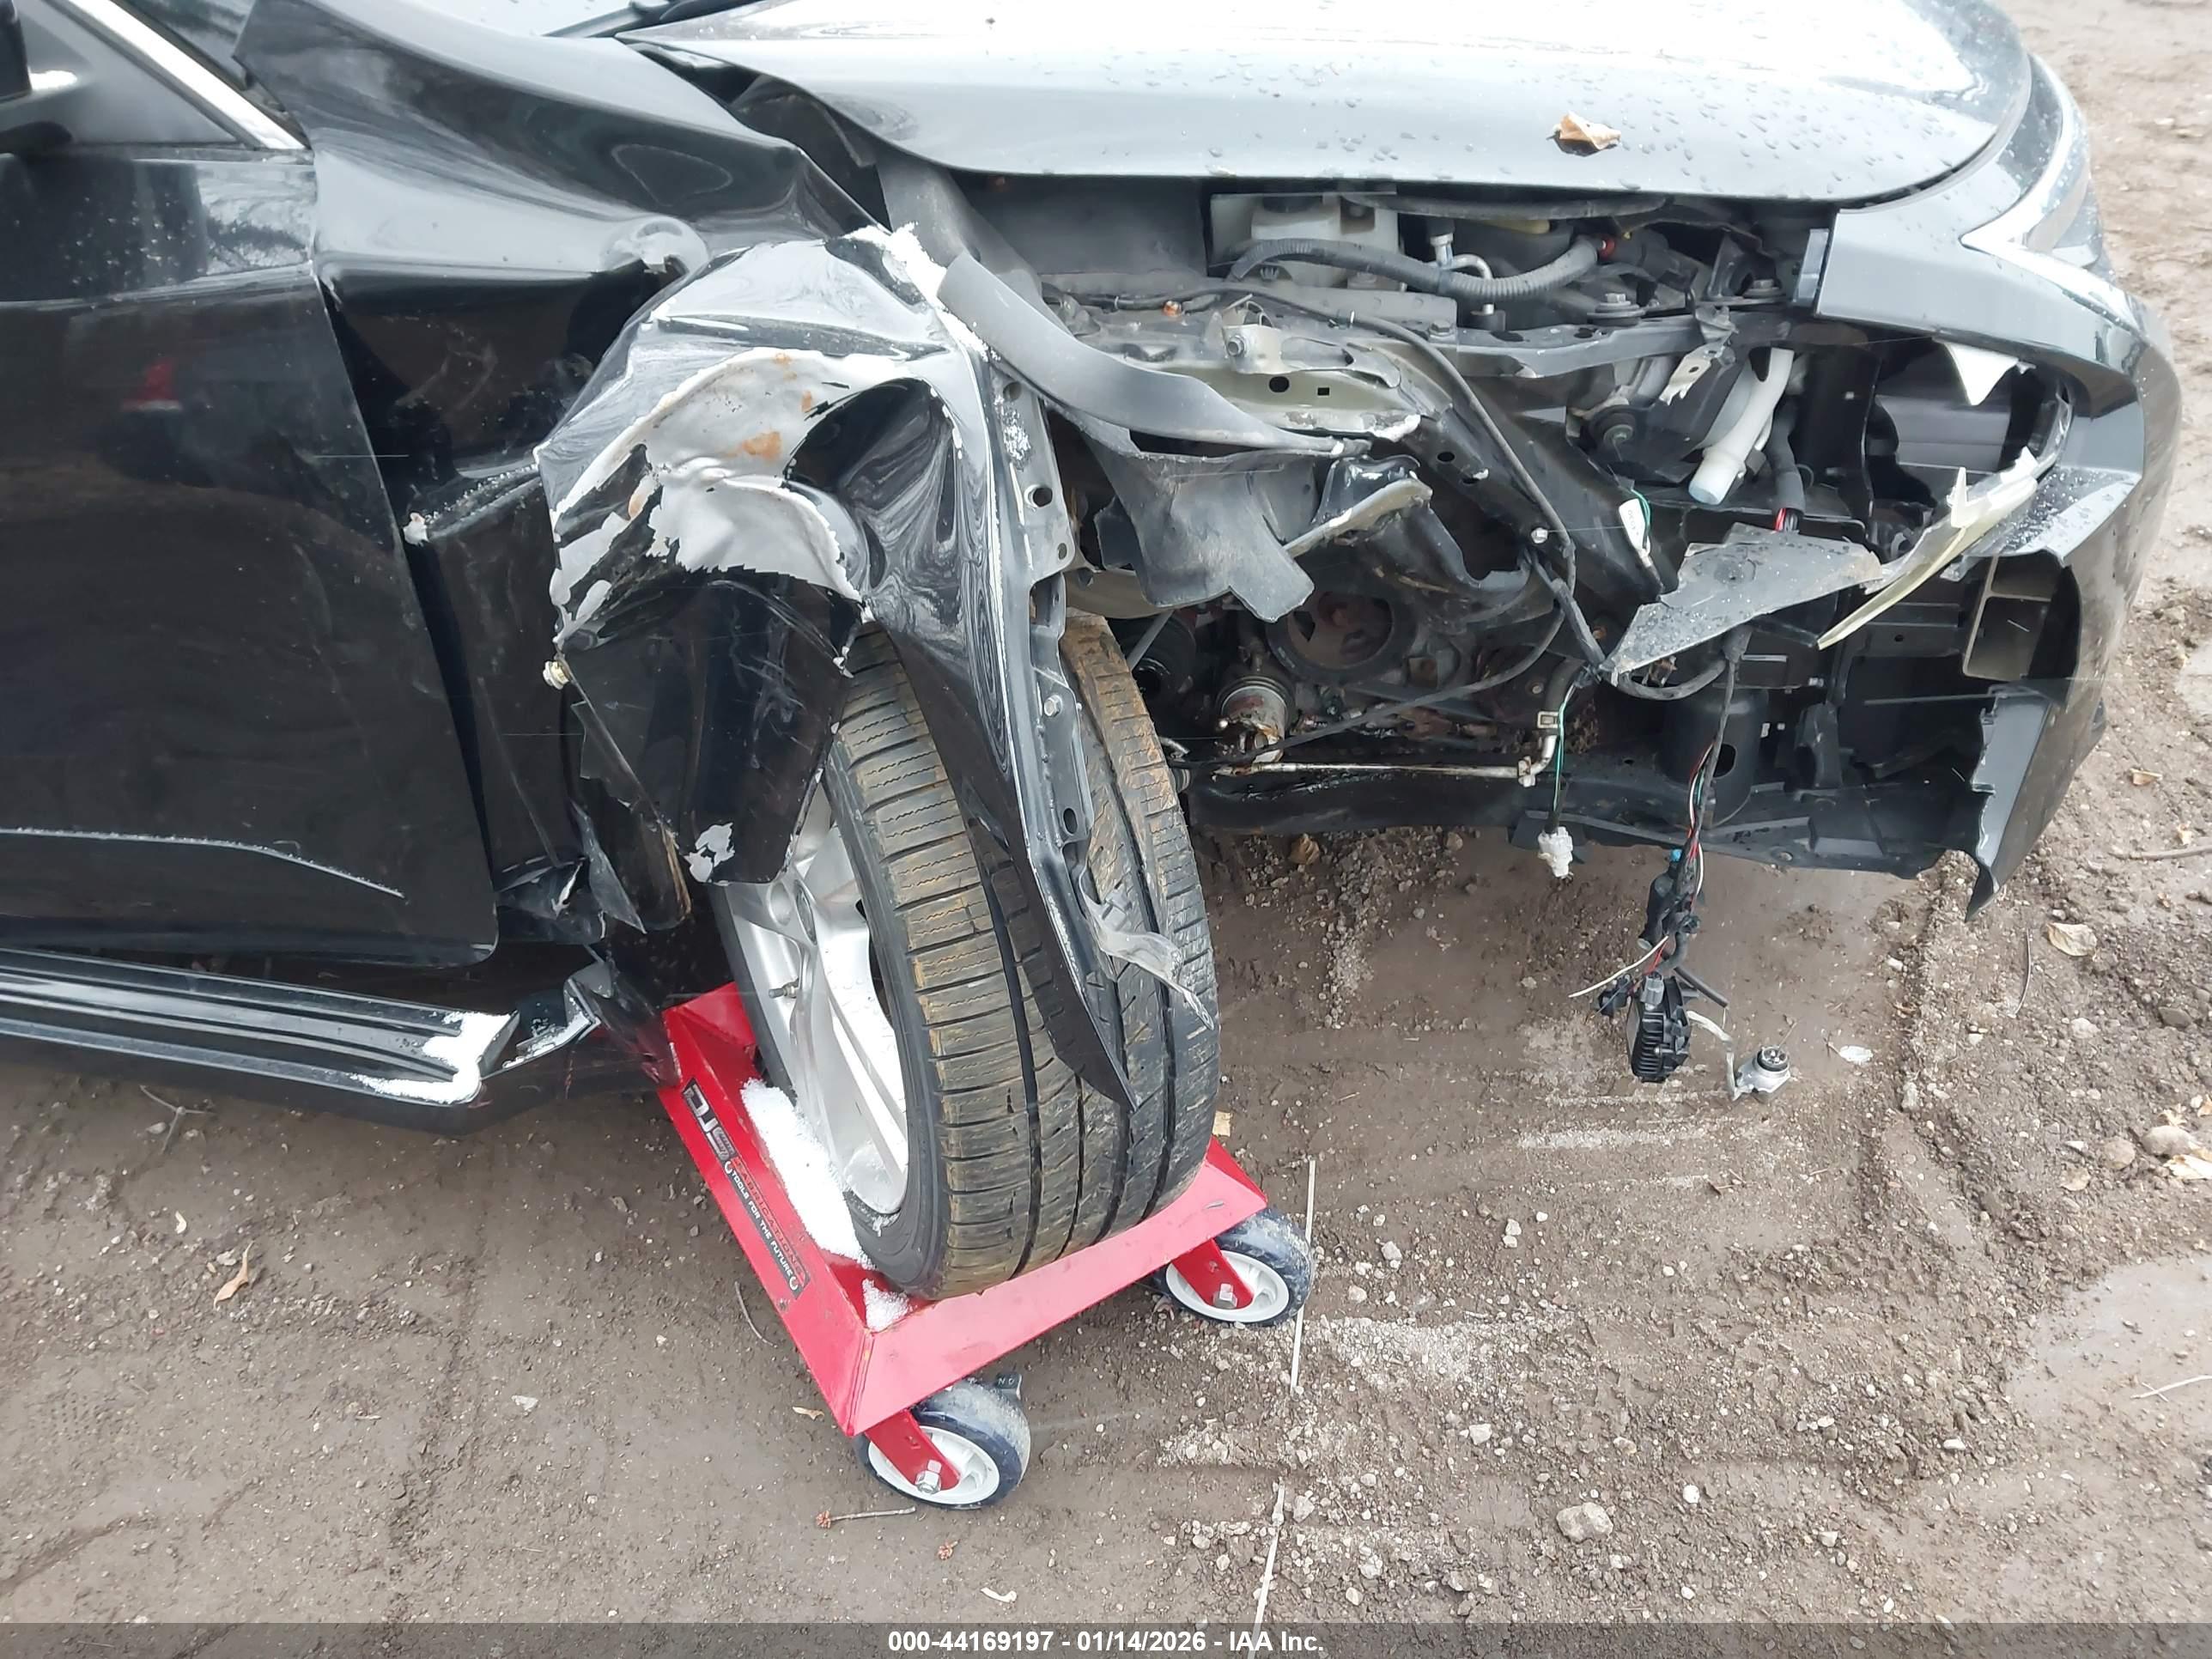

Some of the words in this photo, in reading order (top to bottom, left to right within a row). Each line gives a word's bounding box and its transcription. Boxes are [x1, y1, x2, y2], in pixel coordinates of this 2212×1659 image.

[684, 1084, 734, 1160] DJS
[730, 1170, 750, 1199] TOOLS
[747, 1200, 761, 1218] FOR
[757, 1219, 772, 1239] THE
[770, 1241, 792, 1277] FUTURE
[736, 1160, 802, 1273] FABRICATIONS
